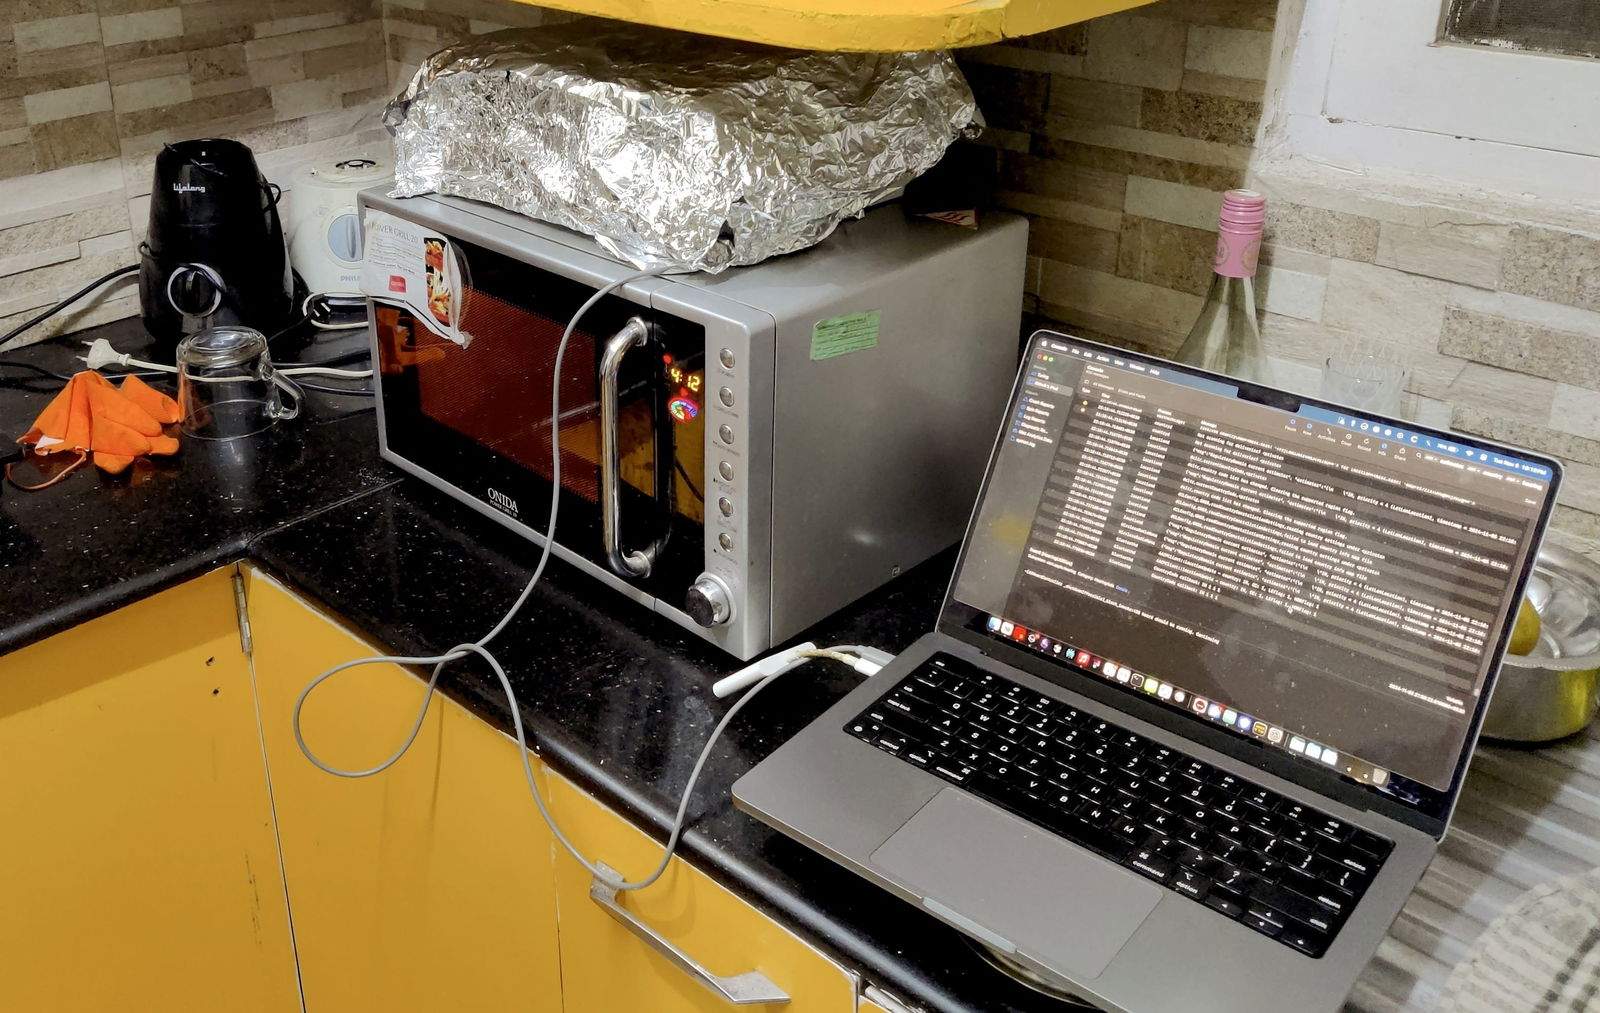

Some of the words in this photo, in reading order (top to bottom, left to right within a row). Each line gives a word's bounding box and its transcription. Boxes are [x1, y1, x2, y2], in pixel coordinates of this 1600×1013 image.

[488, 488, 518, 514] ONIDA
[1132, 860, 1165, 878] command
[1176, 881, 1199, 894] option
